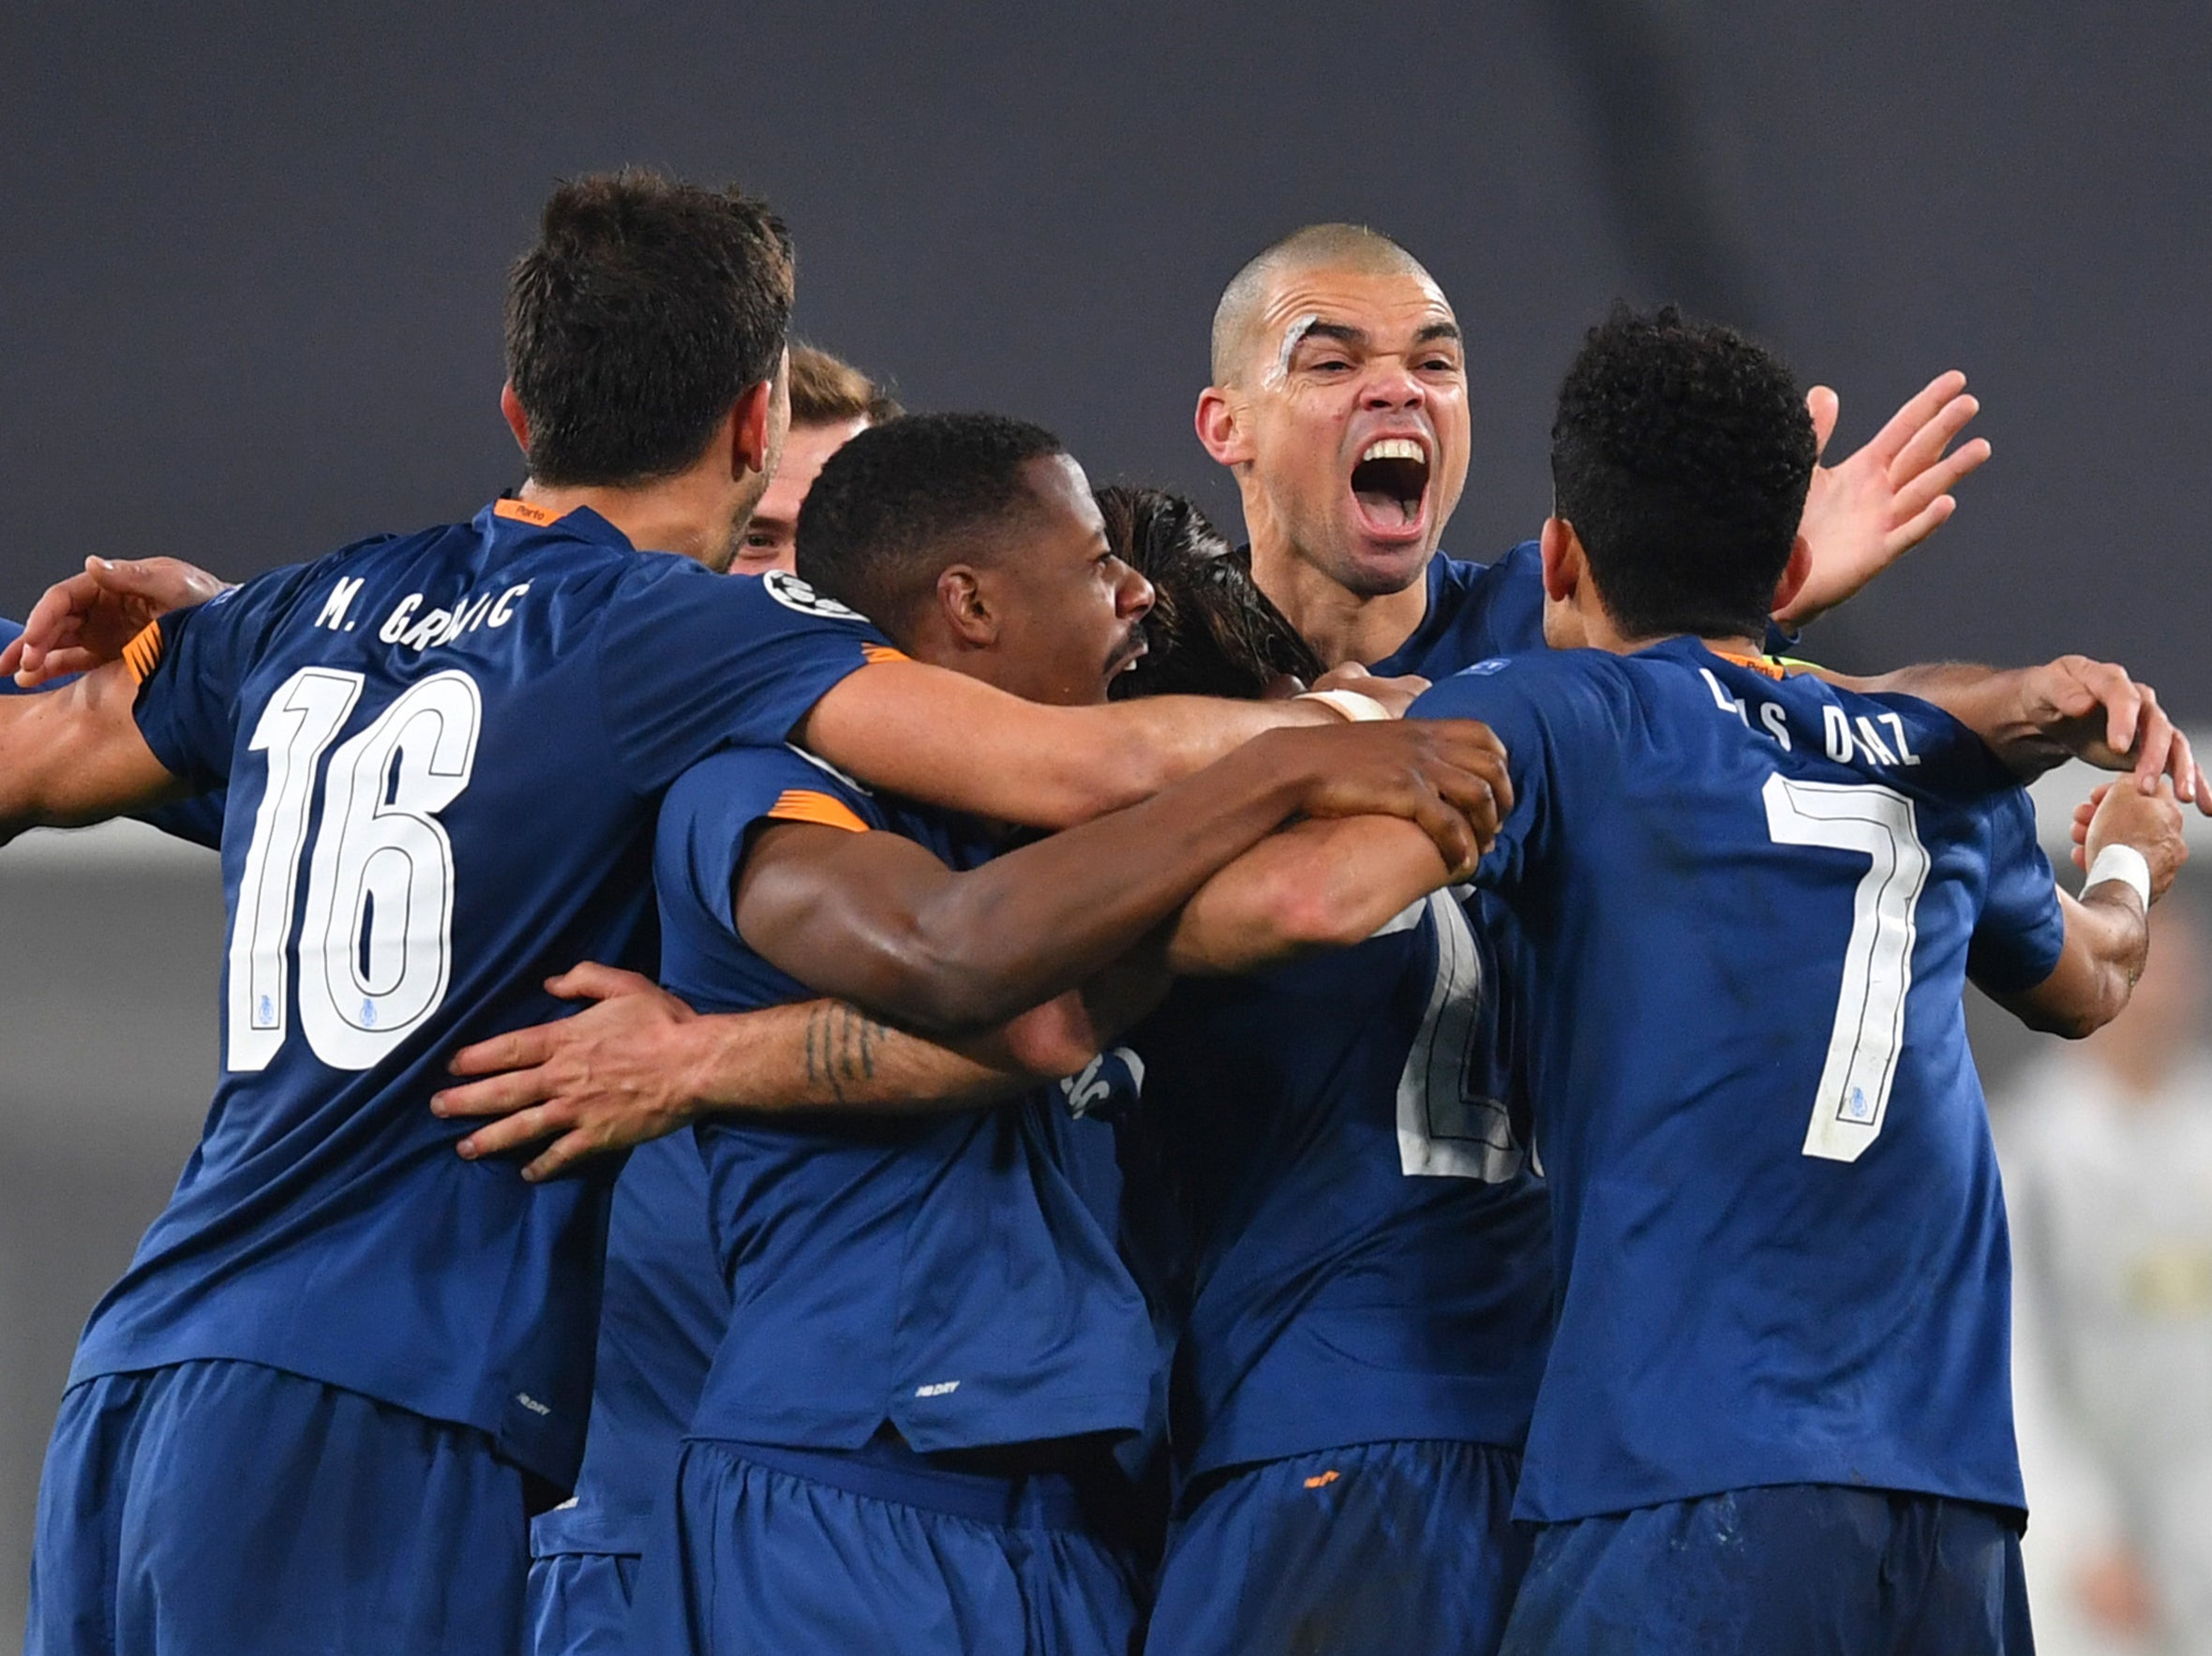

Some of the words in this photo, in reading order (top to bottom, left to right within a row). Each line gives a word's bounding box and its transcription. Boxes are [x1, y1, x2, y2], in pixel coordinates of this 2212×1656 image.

[314, 575, 366, 632] M.
[516, 505, 543, 520] Porto
[227, 667, 483, 1072] 16
[1762, 771, 1931, 1163] 7
